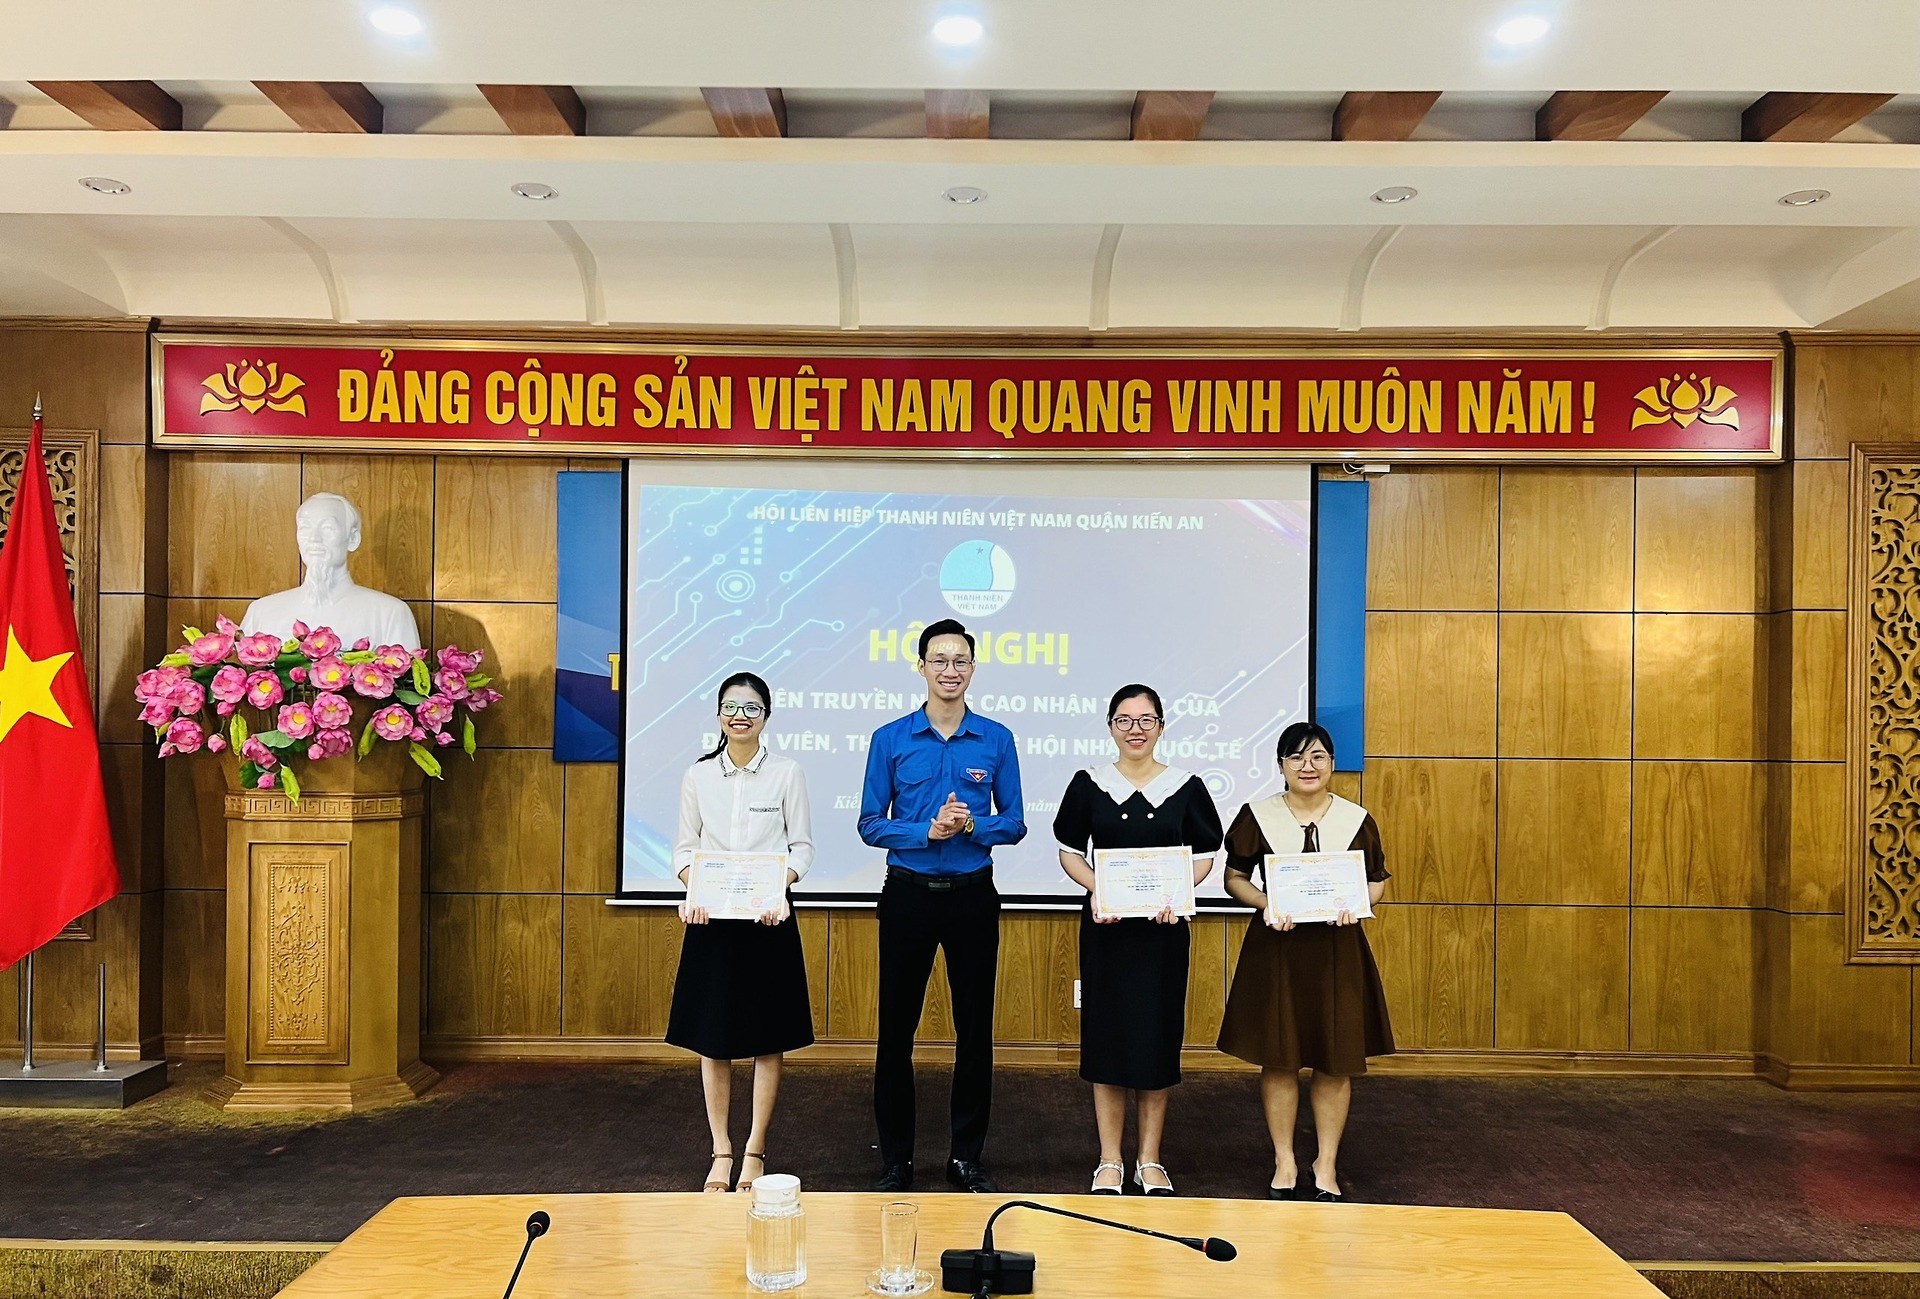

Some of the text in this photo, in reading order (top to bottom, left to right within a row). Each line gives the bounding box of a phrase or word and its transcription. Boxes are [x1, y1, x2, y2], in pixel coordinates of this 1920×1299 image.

[337, 348, 470, 424] ĐẢNG
[484, 358, 616, 437] CỘNG
[633, 355, 732, 430] SẢN
[748, 365, 848, 443] VIỆT
[861, 378, 971, 433] NAM
[988, 378, 1152, 439] QUANG
[1166, 380, 1282, 433] VINH
[1297, 366, 1442, 434] MUÔN
[753, 504, 1204, 533] HỘI LIÊN HIỆP THANH NIÊN VIỆT NAM QUẬN KIẾN AN
[869, 621, 923, 672] HỘ
[810, 688, 902, 710] TRUYỀN
[980, 695, 1027, 712] CAO
[1033, 693, 1097, 717] NHẬN
[1027, 733, 1066, 758] HỘI
[1214, 736, 1244, 759] TẾ
[833, 792, 1058, 812] Kiế năm
